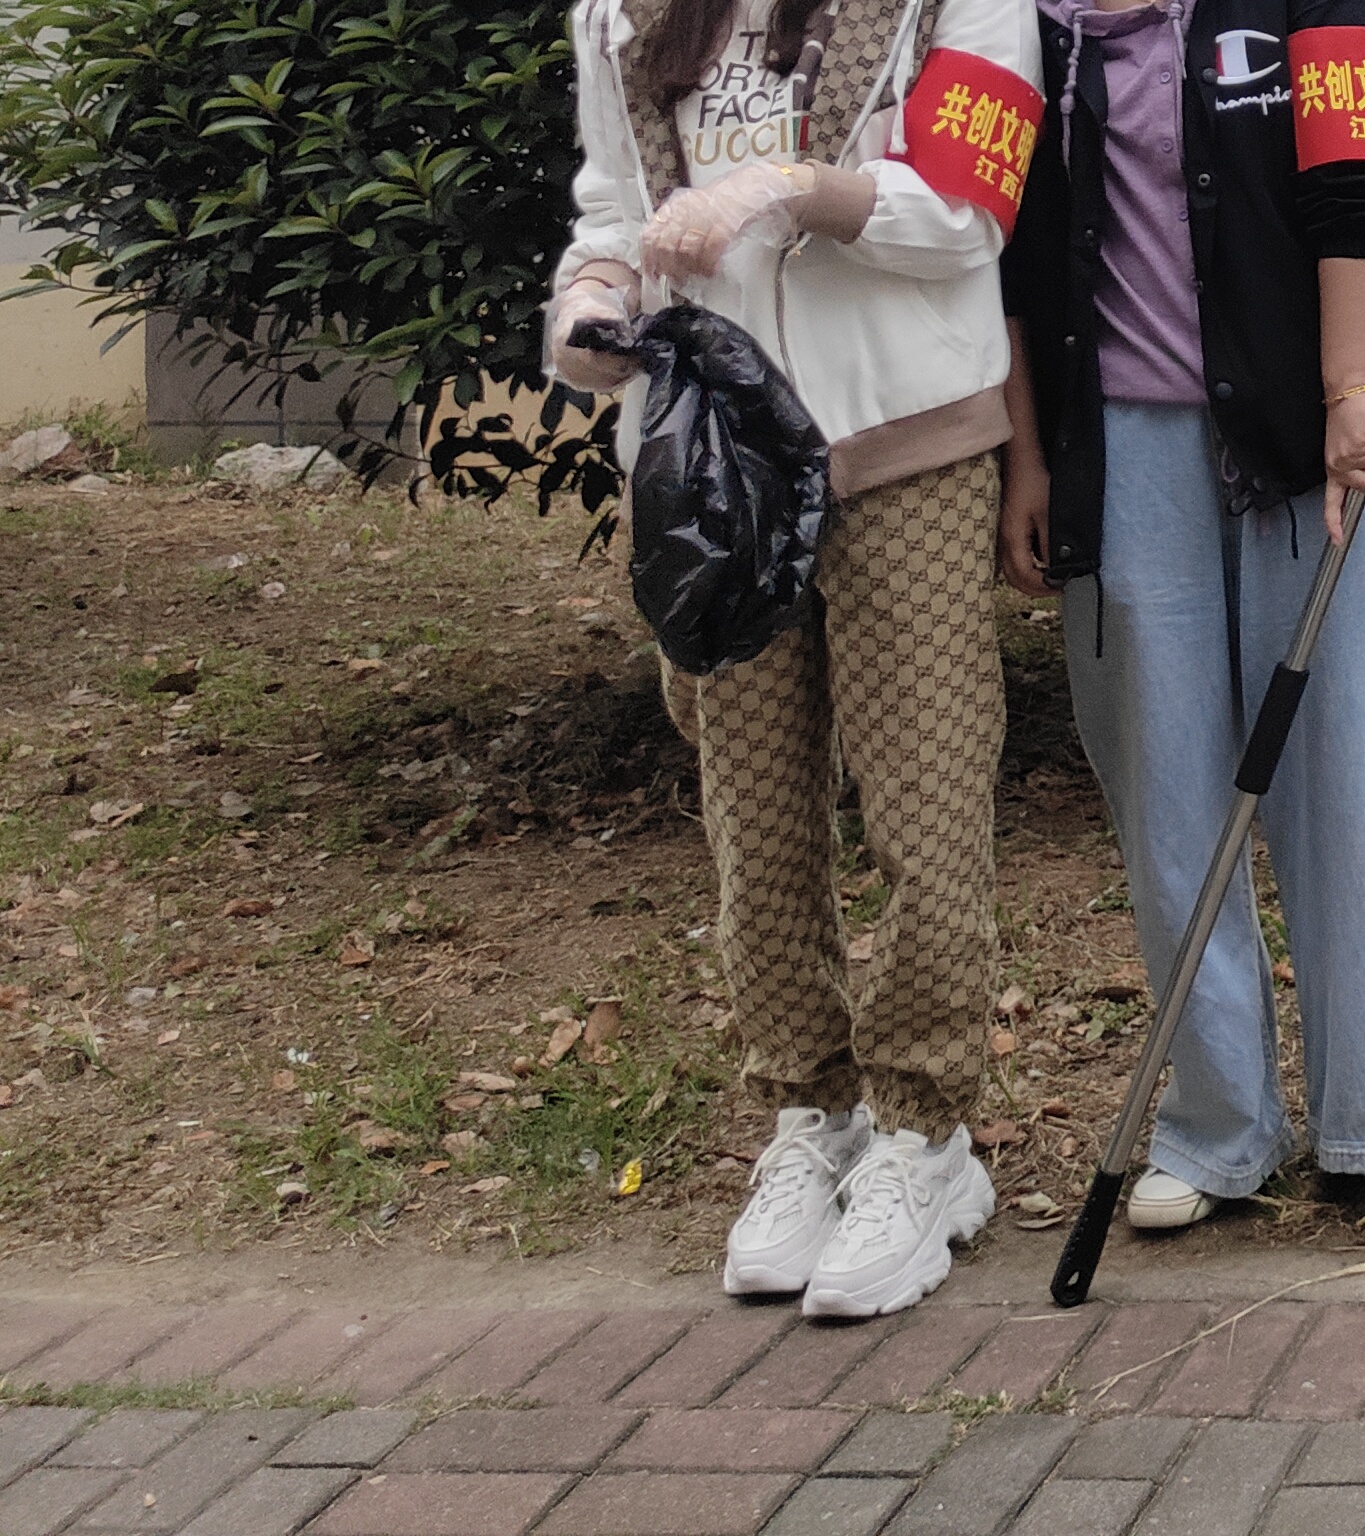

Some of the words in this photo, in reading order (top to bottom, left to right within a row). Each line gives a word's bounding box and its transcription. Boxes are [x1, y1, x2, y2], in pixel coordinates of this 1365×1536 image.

[698, 59, 788, 92] ORT
[697, 88, 788, 128] FACE
[974, 154, 1024, 207] 江西
